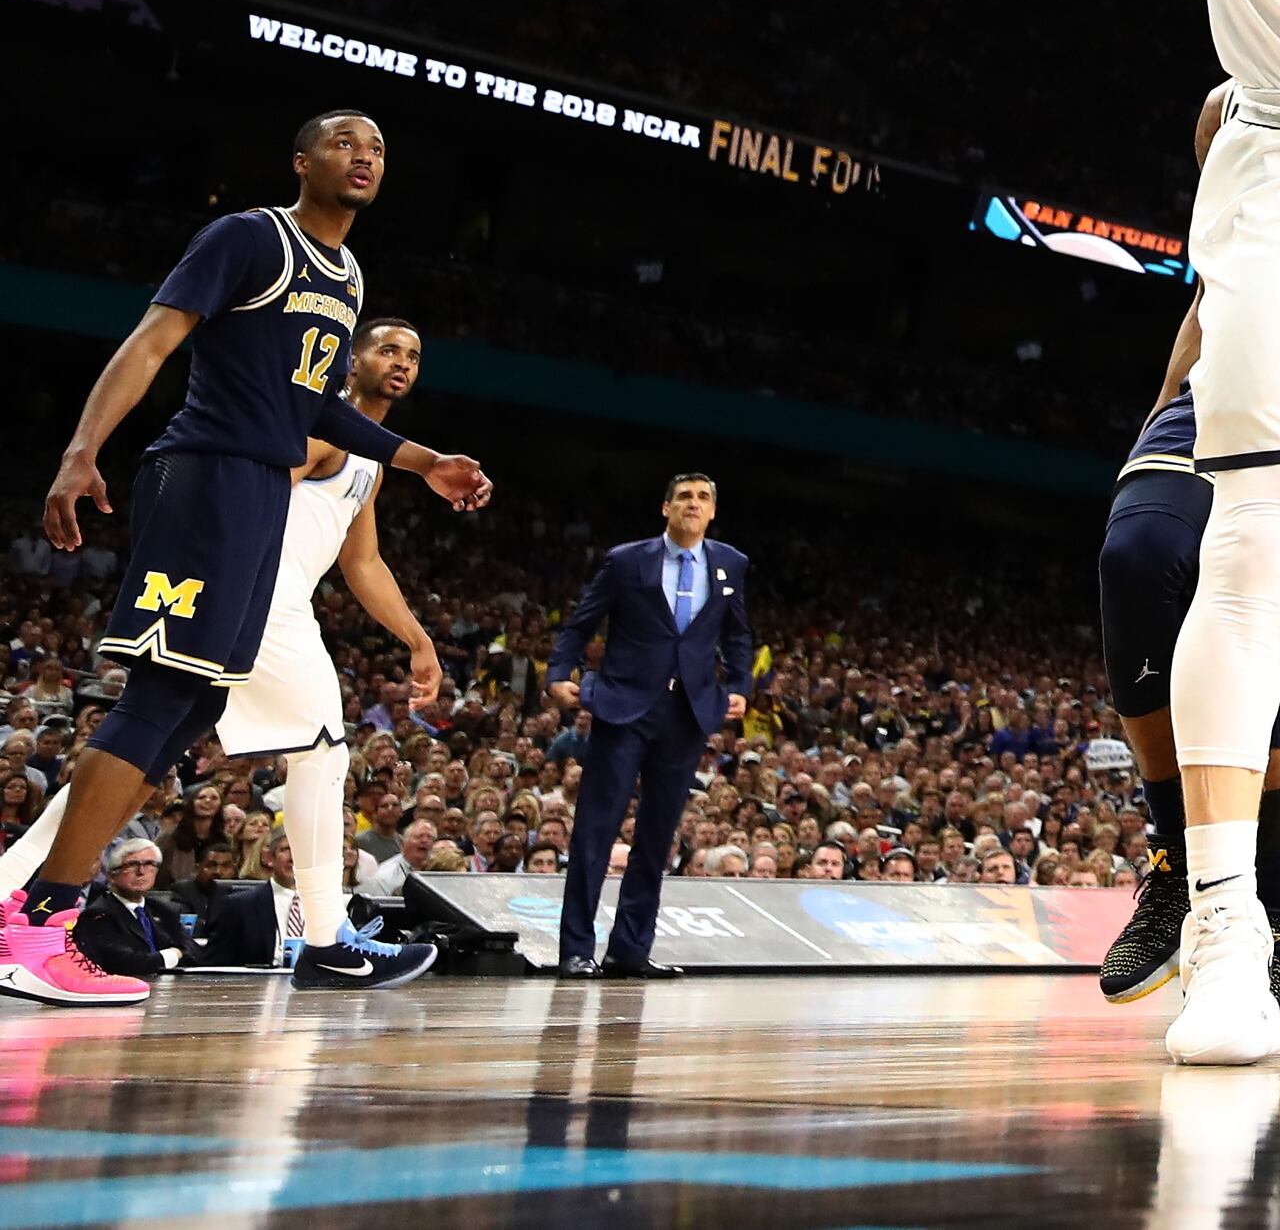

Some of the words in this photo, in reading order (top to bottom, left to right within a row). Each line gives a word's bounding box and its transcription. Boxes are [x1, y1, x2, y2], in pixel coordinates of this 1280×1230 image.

[249, 14, 419, 77] WELCOME
[425, 58, 467, 89] TO
[474, 71, 537, 107] THE
[543, 89, 617, 127] 2018
[622, 109, 700, 148] NCAA
[708, 120, 799, 182] FINAL
[1023, 200, 1074, 229] SAN
[1075, 214, 1183, 257] ANTONIO
[283, 291, 357, 336] MICHIGA
[291, 326, 340, 395] 12
[134, 570, 205, 620] M
